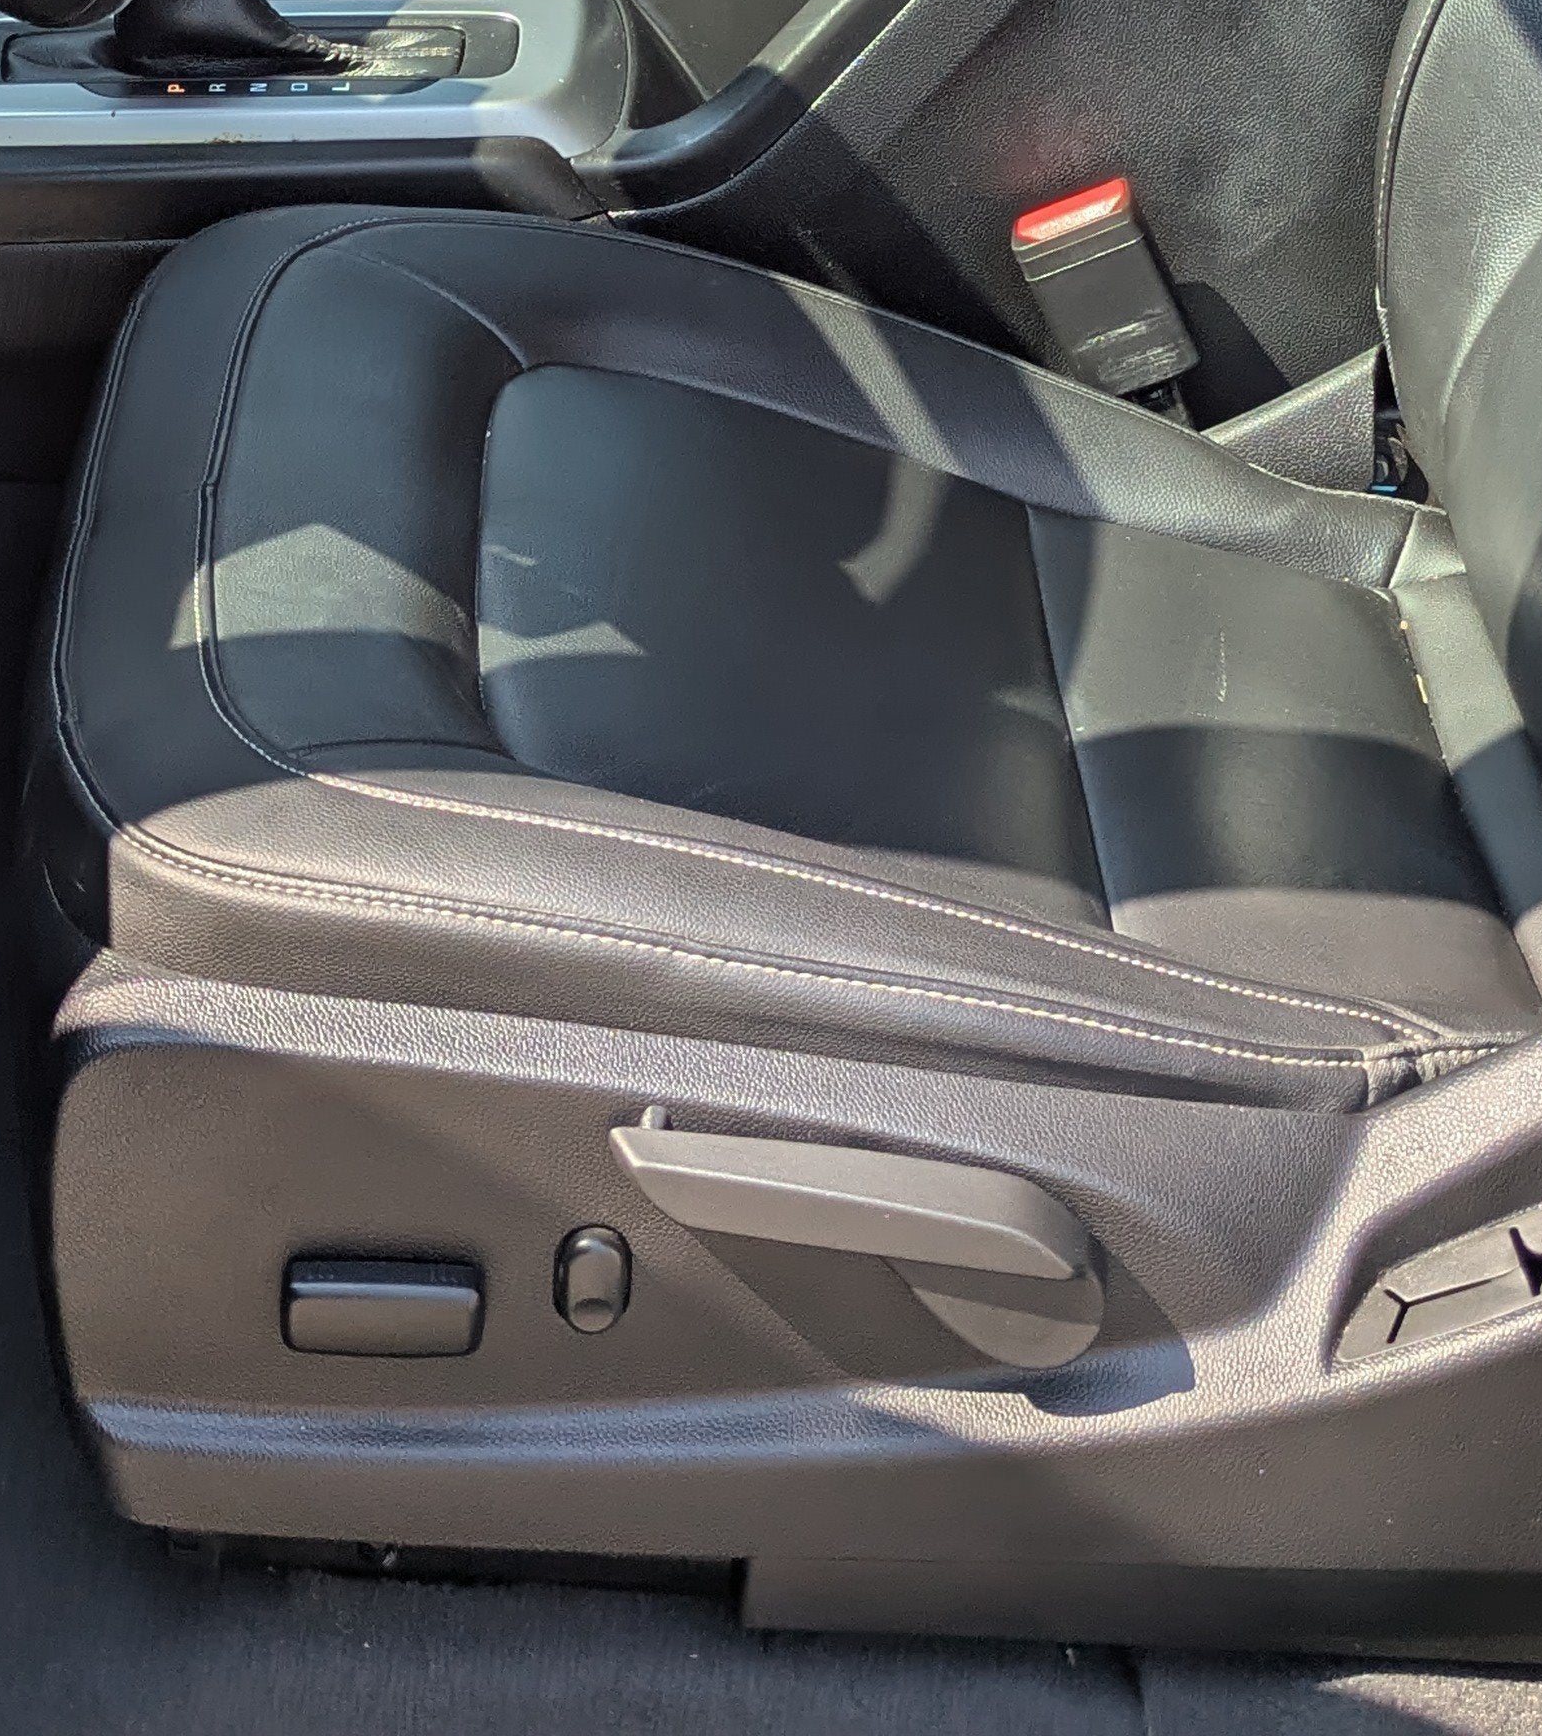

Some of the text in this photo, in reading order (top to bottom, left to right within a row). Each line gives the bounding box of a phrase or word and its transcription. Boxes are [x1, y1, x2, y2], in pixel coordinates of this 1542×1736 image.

[167, 81, 350, 93] P R N D L
